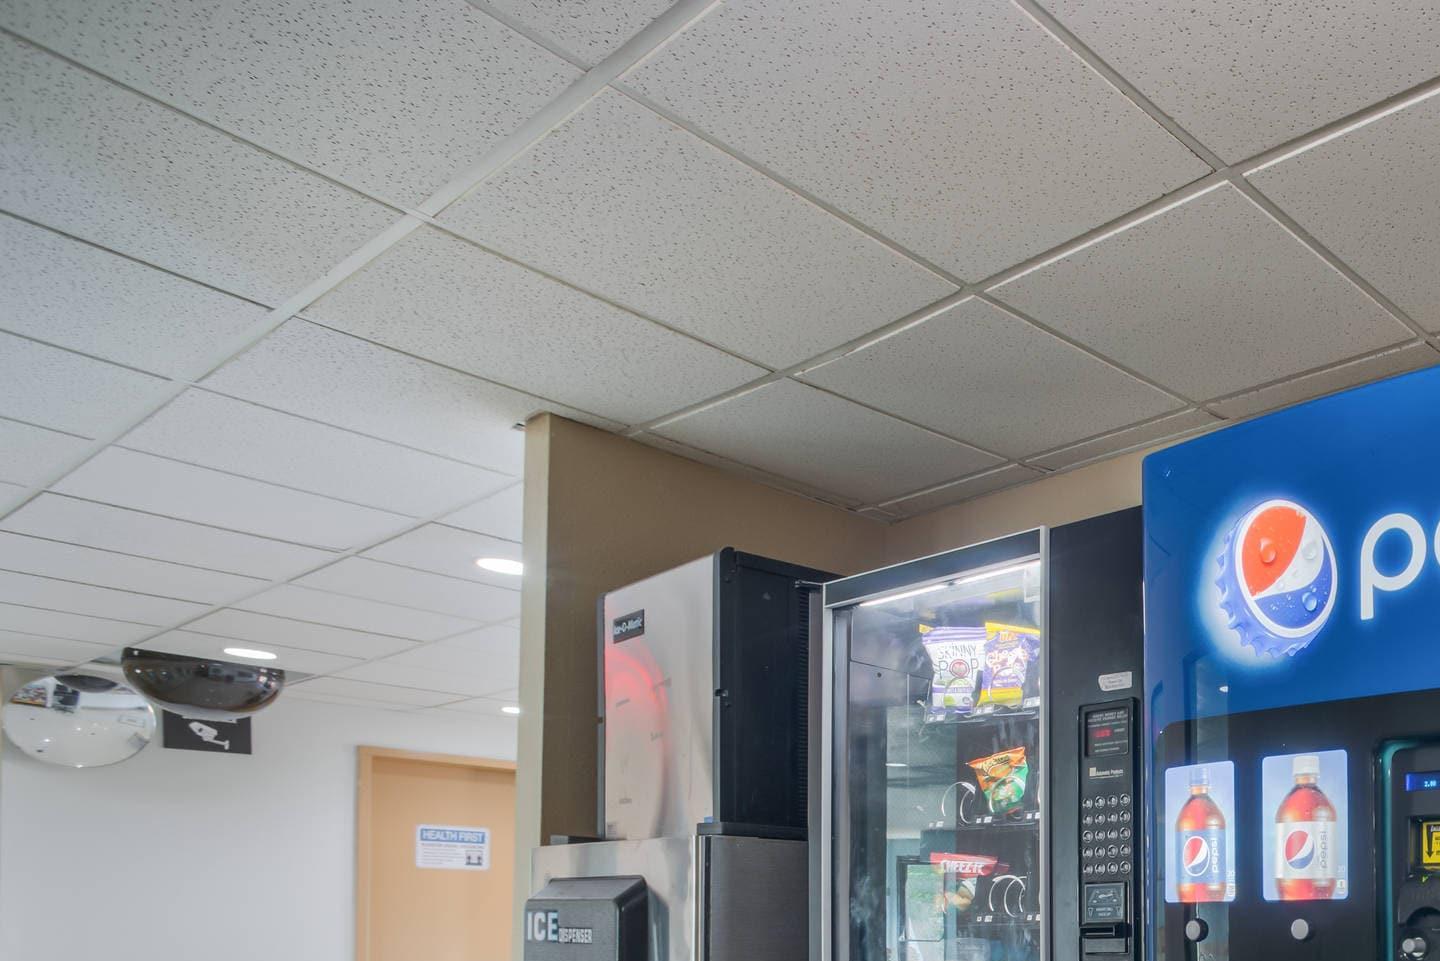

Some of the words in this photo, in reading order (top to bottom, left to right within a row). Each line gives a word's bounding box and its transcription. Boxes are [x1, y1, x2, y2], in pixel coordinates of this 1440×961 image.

[938, 644, 977, 660] SKINNY
[422, 830, 458, 841] HEALTH
[458, 832, 484, 843] FIRST
[1320, 831, 1328, 869] pepsi
[1211, 838, 1219, 873] pepsi
[527, 911, 558, 941] ICE
[558, 927, 592, 943] DISPENSER
